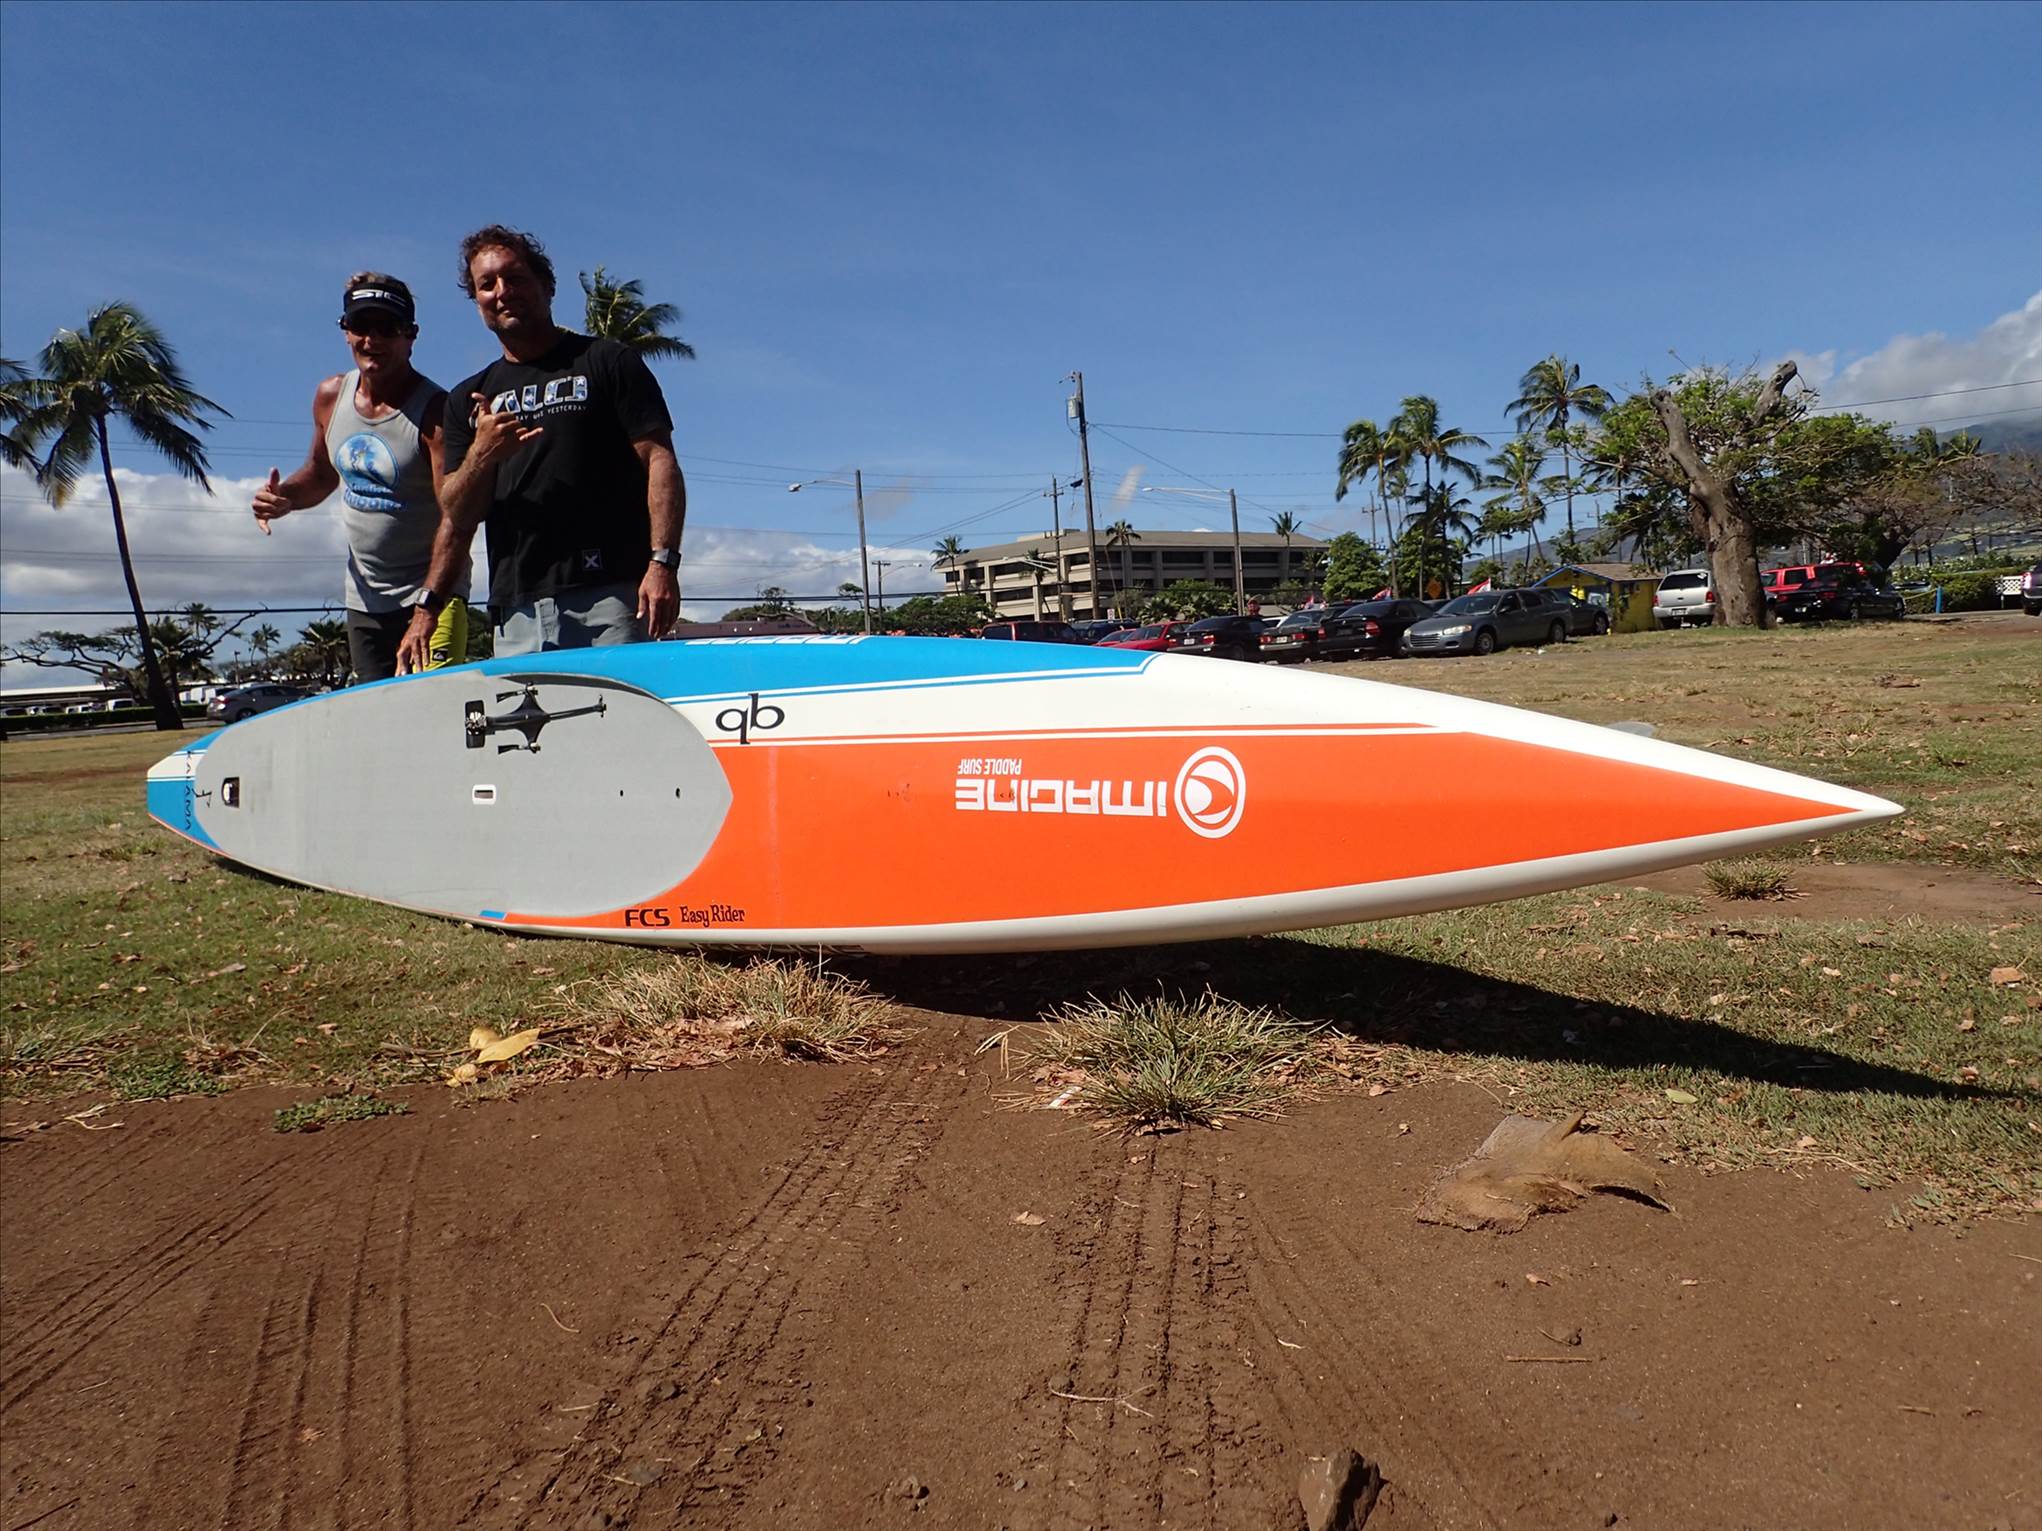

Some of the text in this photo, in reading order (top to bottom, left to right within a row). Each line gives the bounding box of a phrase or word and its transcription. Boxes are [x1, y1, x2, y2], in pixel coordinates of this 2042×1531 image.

[715, 692, 785, 745] qb
[957, 758, 1022, 775] PADDLE SURF
[955, 778, 1168, 817] IMAGINE
[625, 908, 671, 927] FCS
[680, 904, 745, 928] Easy Rider
